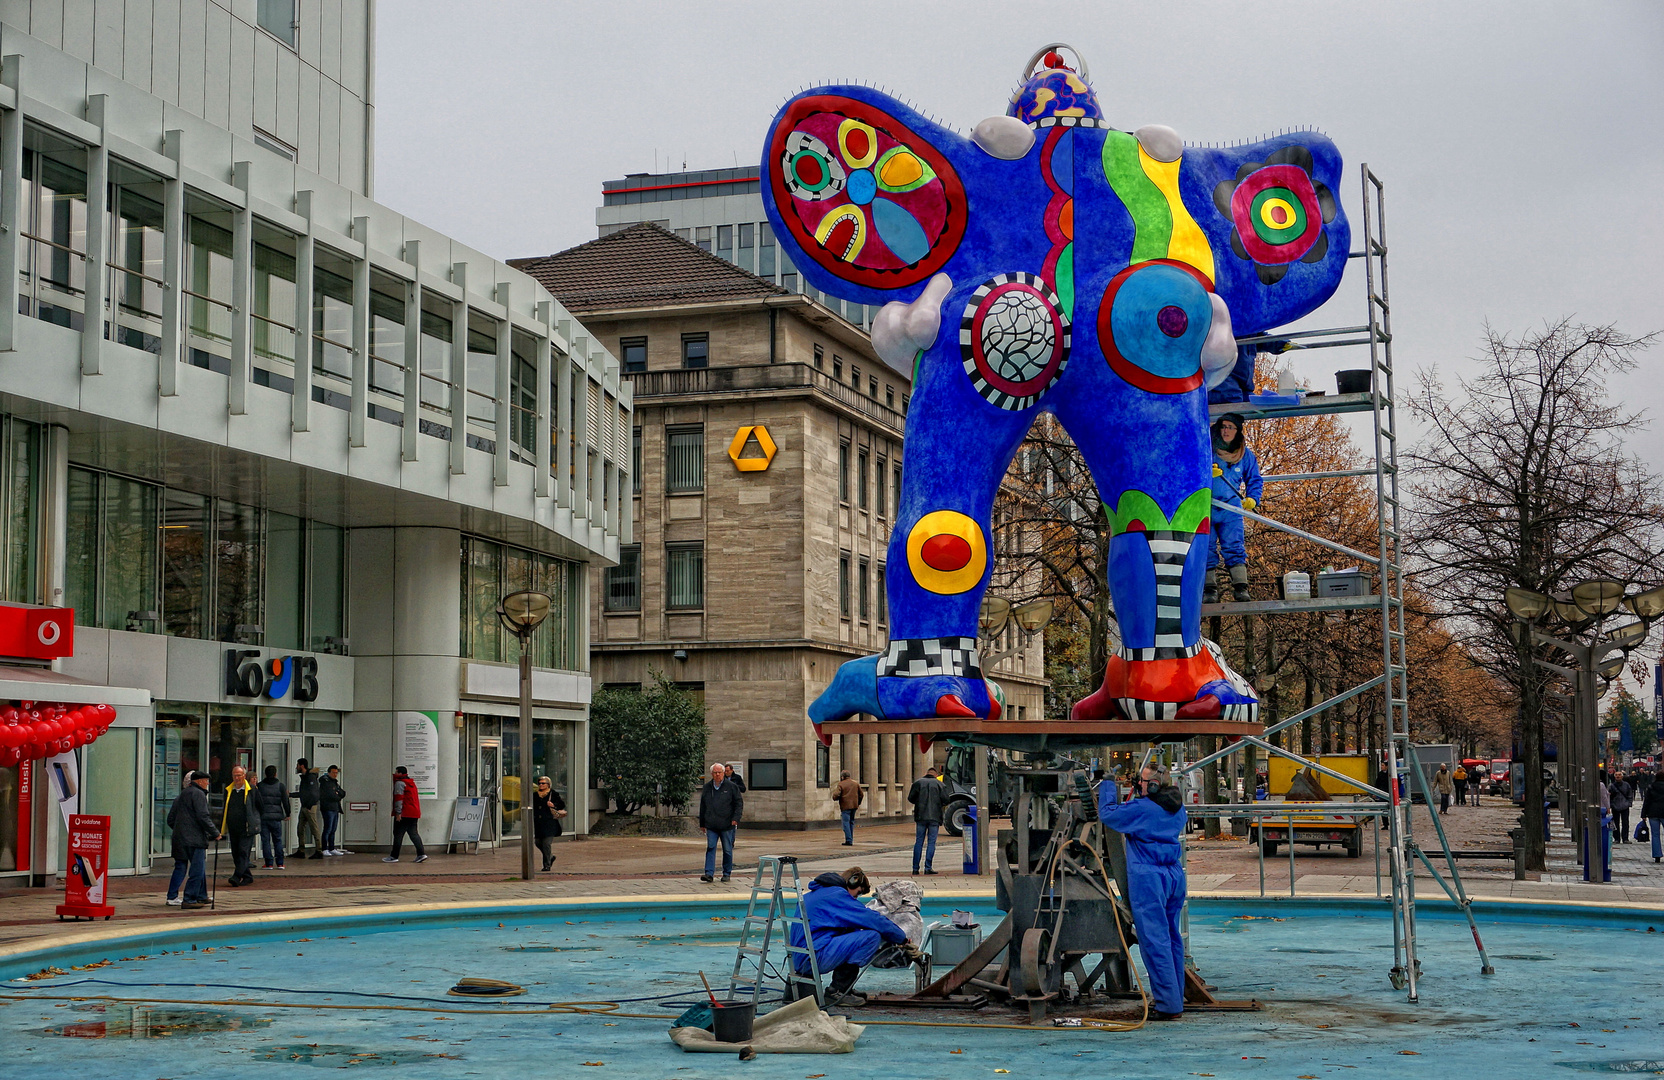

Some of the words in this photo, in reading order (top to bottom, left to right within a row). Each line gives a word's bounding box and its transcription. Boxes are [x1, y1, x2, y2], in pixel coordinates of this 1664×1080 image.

[292, 656, 318, 702] 13
[72, 832, 81, 848] 3
[81, 832, 103, 840] MONATE
